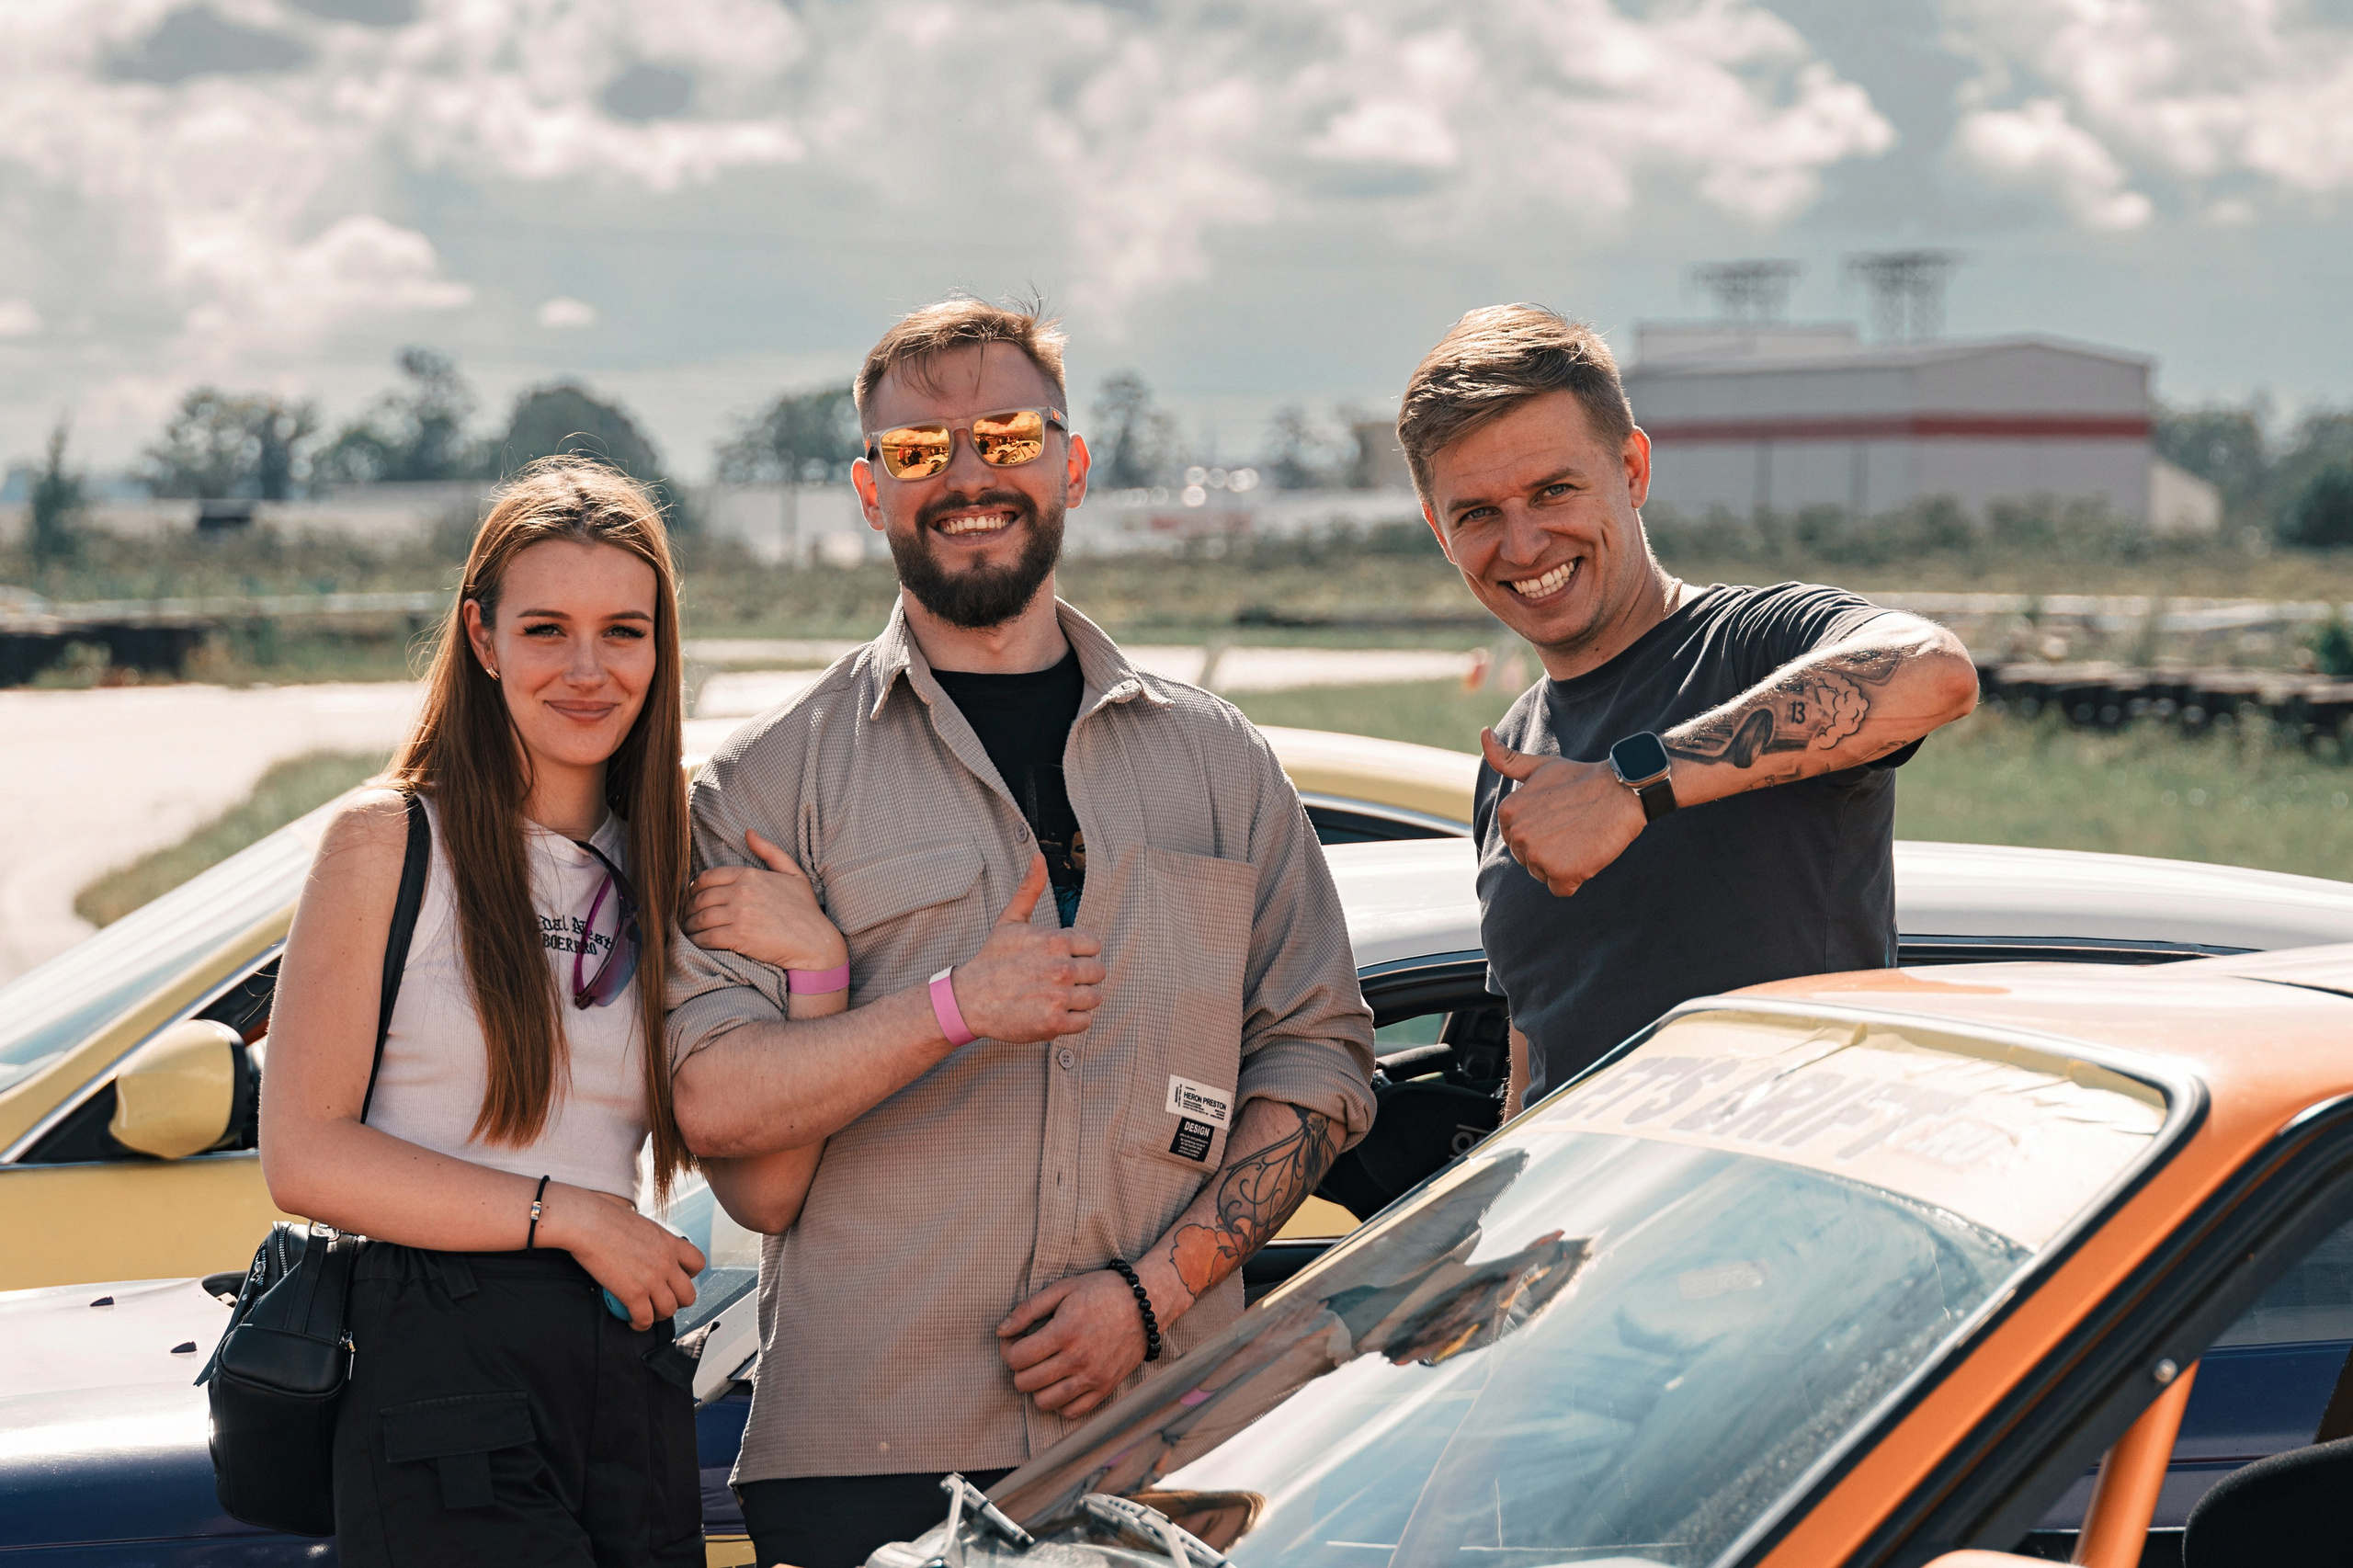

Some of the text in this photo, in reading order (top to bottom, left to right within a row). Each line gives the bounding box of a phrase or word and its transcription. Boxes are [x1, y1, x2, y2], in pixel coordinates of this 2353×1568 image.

[1790, 700, 1806, 724] 13
[1183, 1091, 1203, 1104] HERON
[1202, 1096, 1227, 1111] PRESTON
[1184, 1120, 1211, 1138] DESIGN
